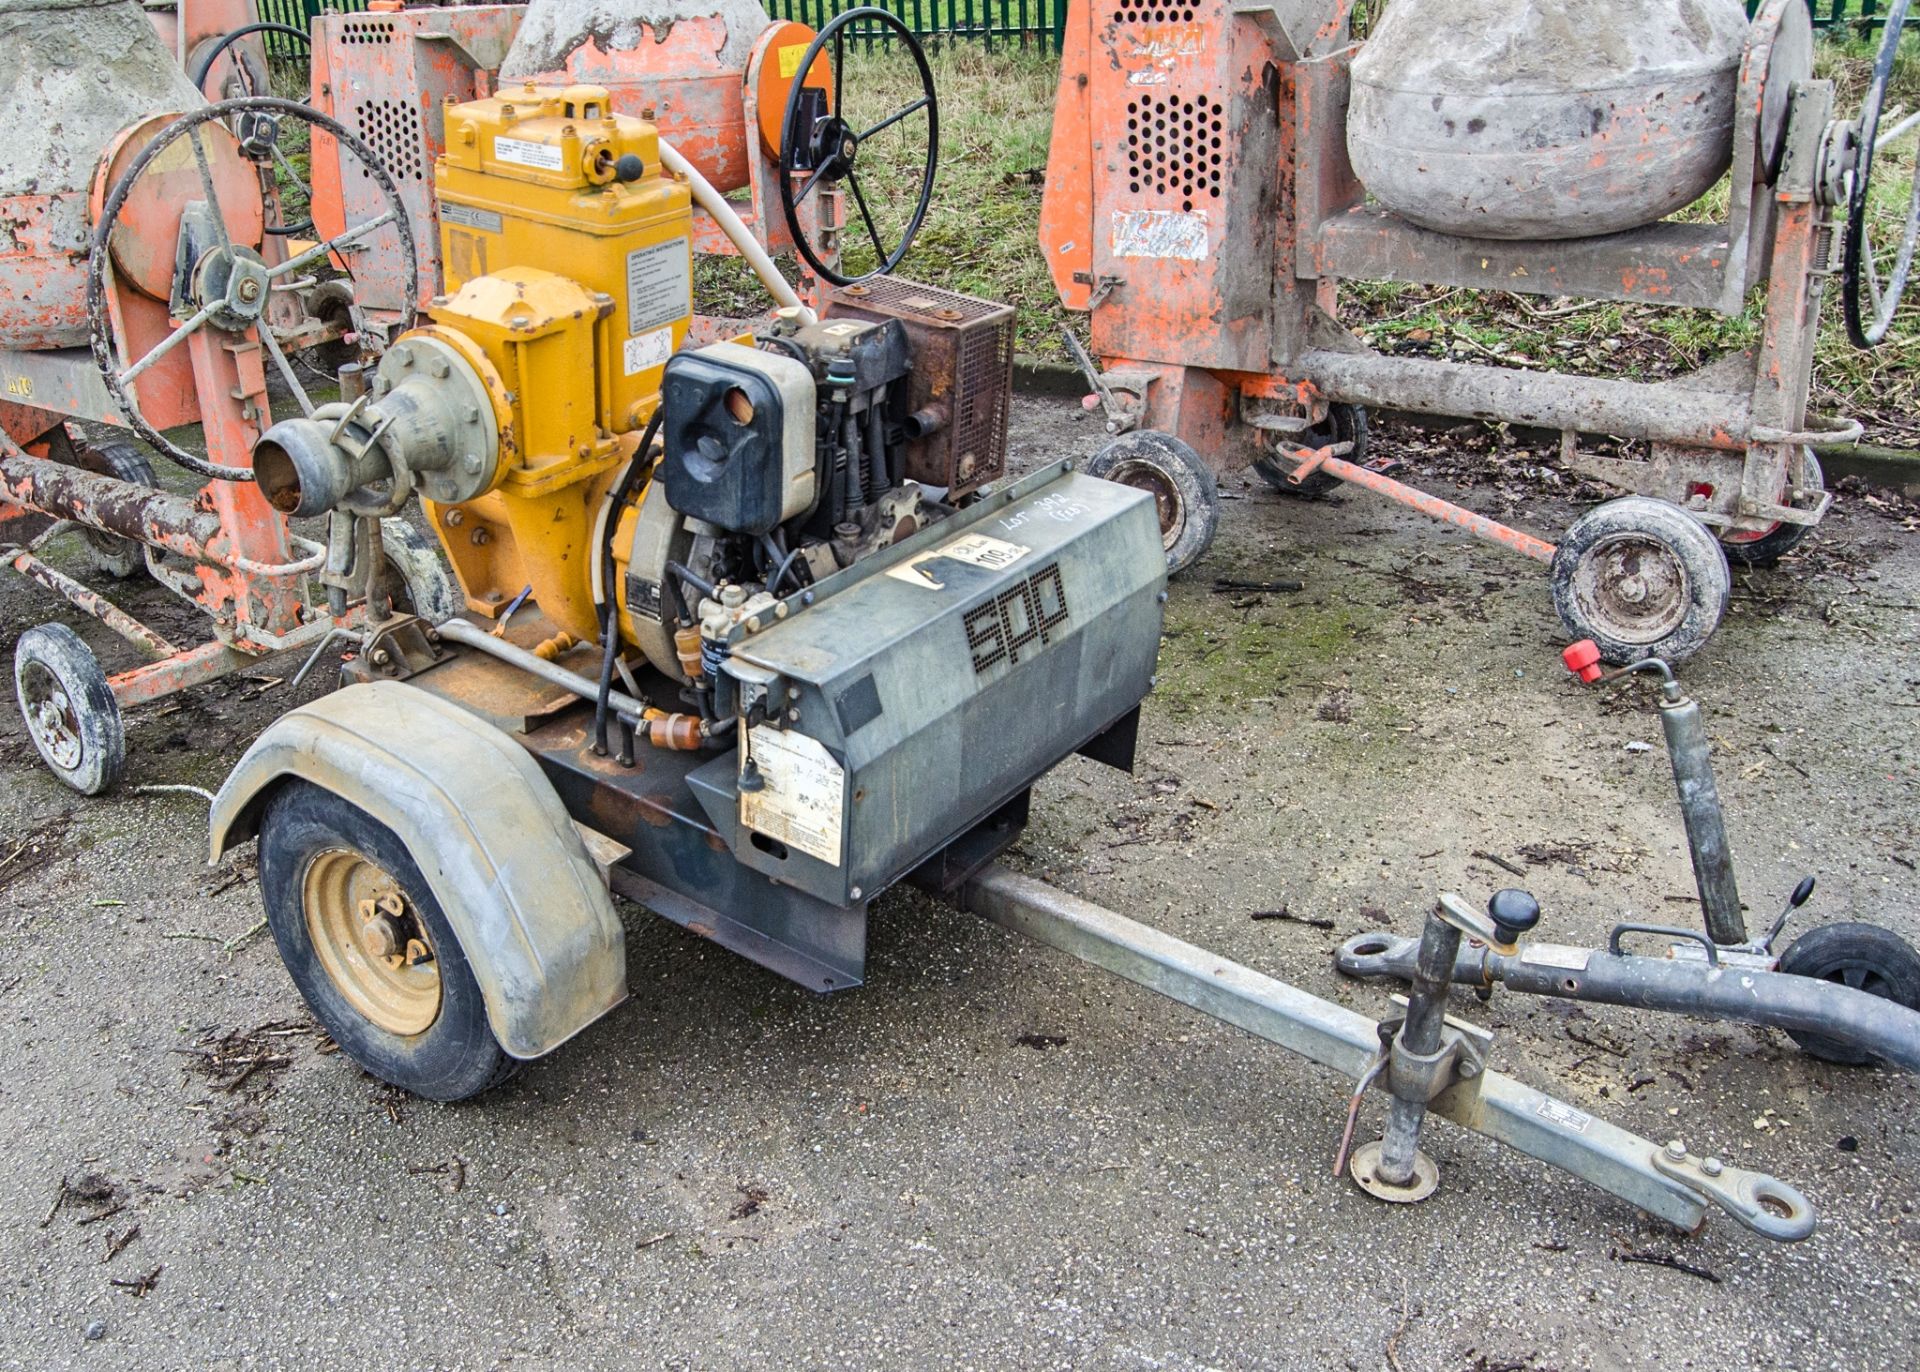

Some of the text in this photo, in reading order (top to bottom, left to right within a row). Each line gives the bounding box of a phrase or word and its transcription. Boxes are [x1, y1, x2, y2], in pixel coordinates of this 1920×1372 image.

[631, 239, 685, 260] OPERATING INSTRUCTIONS
[999, 492, 1071, 531] LOT 392
[975, 549, 1013, 567] 109
